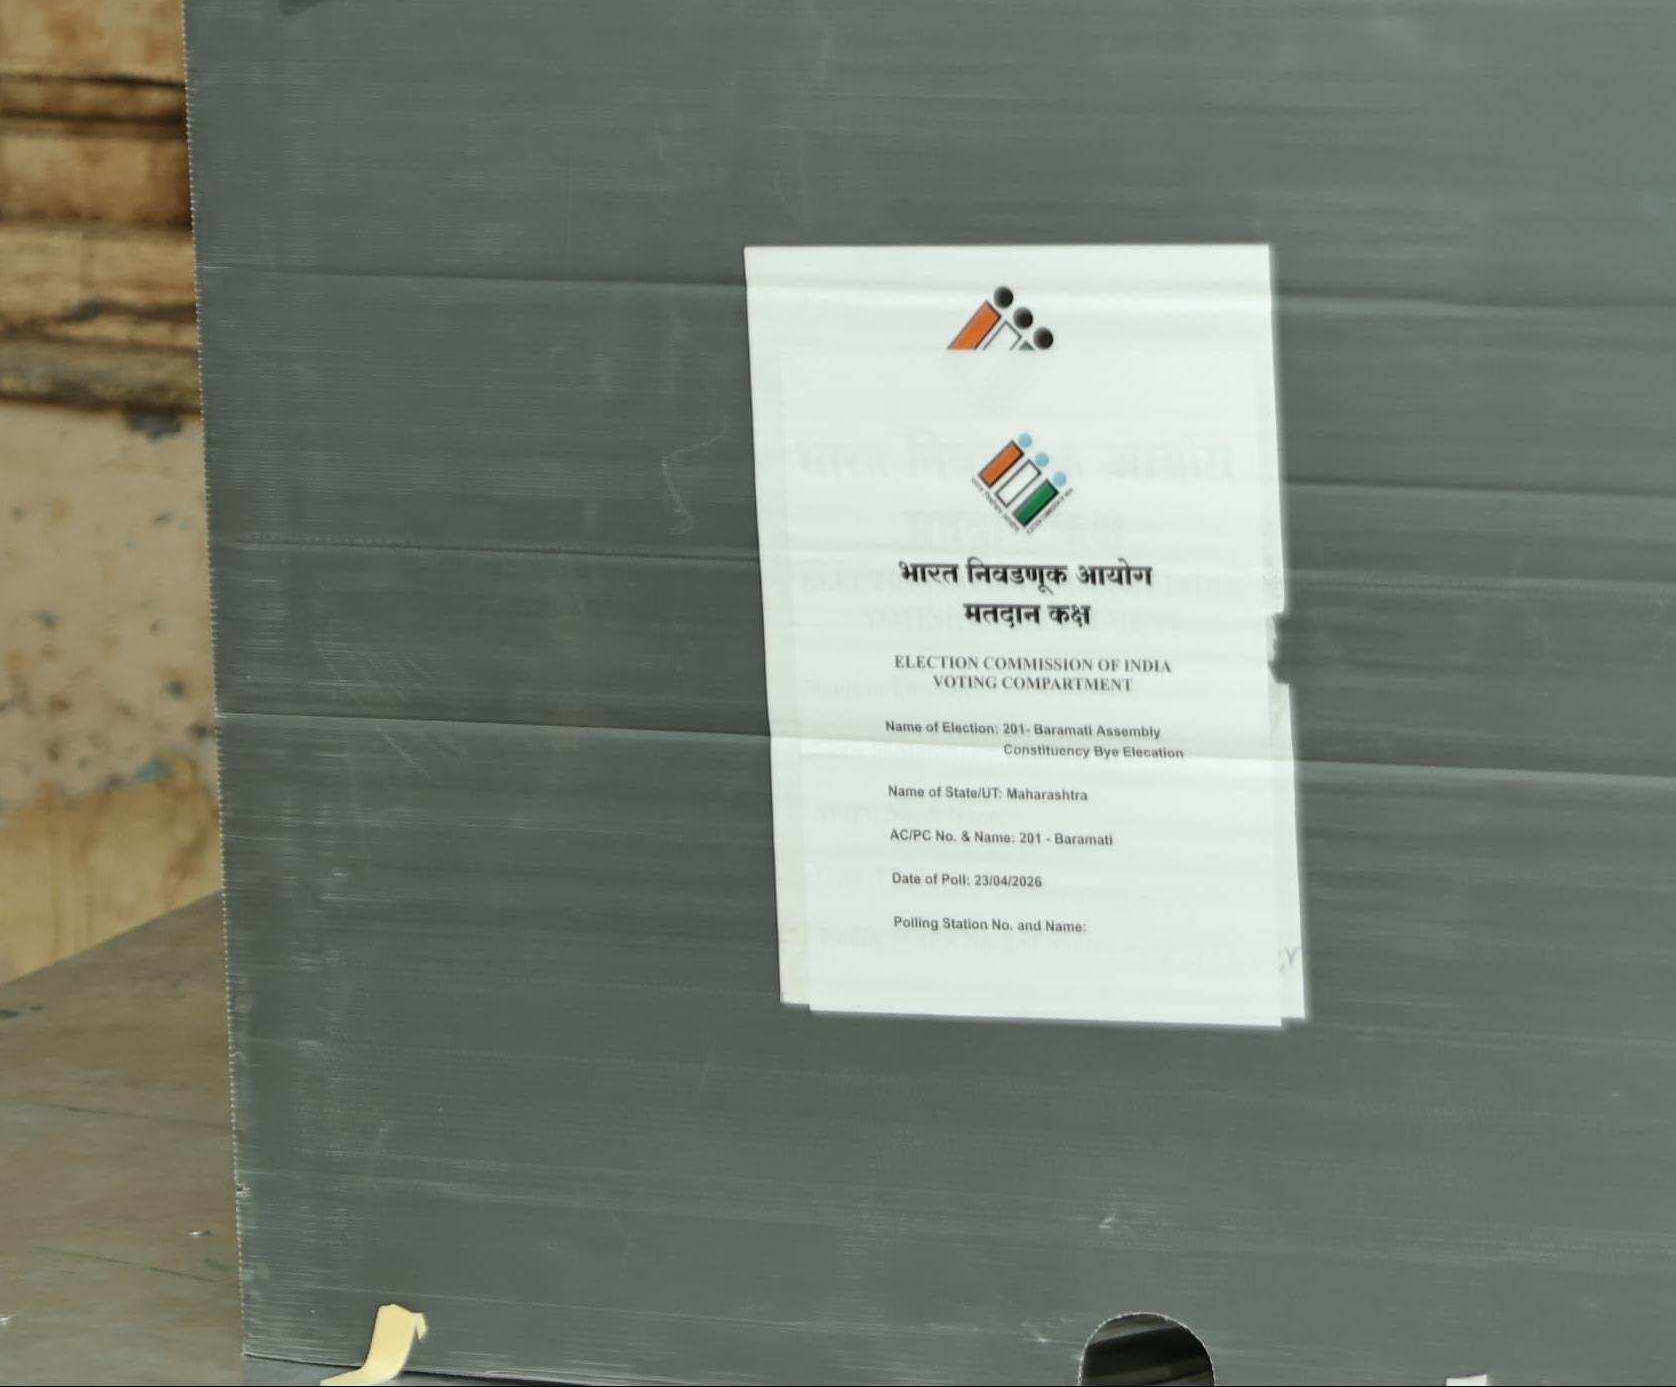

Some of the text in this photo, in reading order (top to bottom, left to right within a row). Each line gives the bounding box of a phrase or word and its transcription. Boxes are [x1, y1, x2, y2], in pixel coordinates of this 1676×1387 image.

[898, 561, 959, 584] भारत
[965, 556, 1068, 594] निवडणूक
[1077, 557, 1154, 587] आयोग
[963, 603, 1041, 629] मतदान
[1047, 604, 1091, 628] कक्ष
[894, 654, 1172, 673] ELECTION COMMISSION OF INDIA
[933, 675, 997, 689] VOTING
[1001, 676, 1133, 693] COMPARTMENT
[885, 720, 923, 733] Name
[925, 721, 939, 733] of
[941, 721, 999, 734] Election:
[1033, 723, 1093, 737] Baramati
[1095, 724, 1161, 741] Assembly
[1003, 743, 1185, 760] Constituency Bye Elecation
[888, 784, 1088, 801] Name of State/UT: Maharashtra
[890, 828, 932, 842] AC/PC
[935, 830, 957, 842] No.
[960, 830, 971, 843] &
[974, 830, 1015, 844] Name:
[1019, 832, 1041, 845] 201
[1054, 832, 1113, 846] Baramati
[891, 871, 1043, 888] Date of Poll: 23/04/2026
[893, 916, 1086, 933] Polling Station No. and Name:
